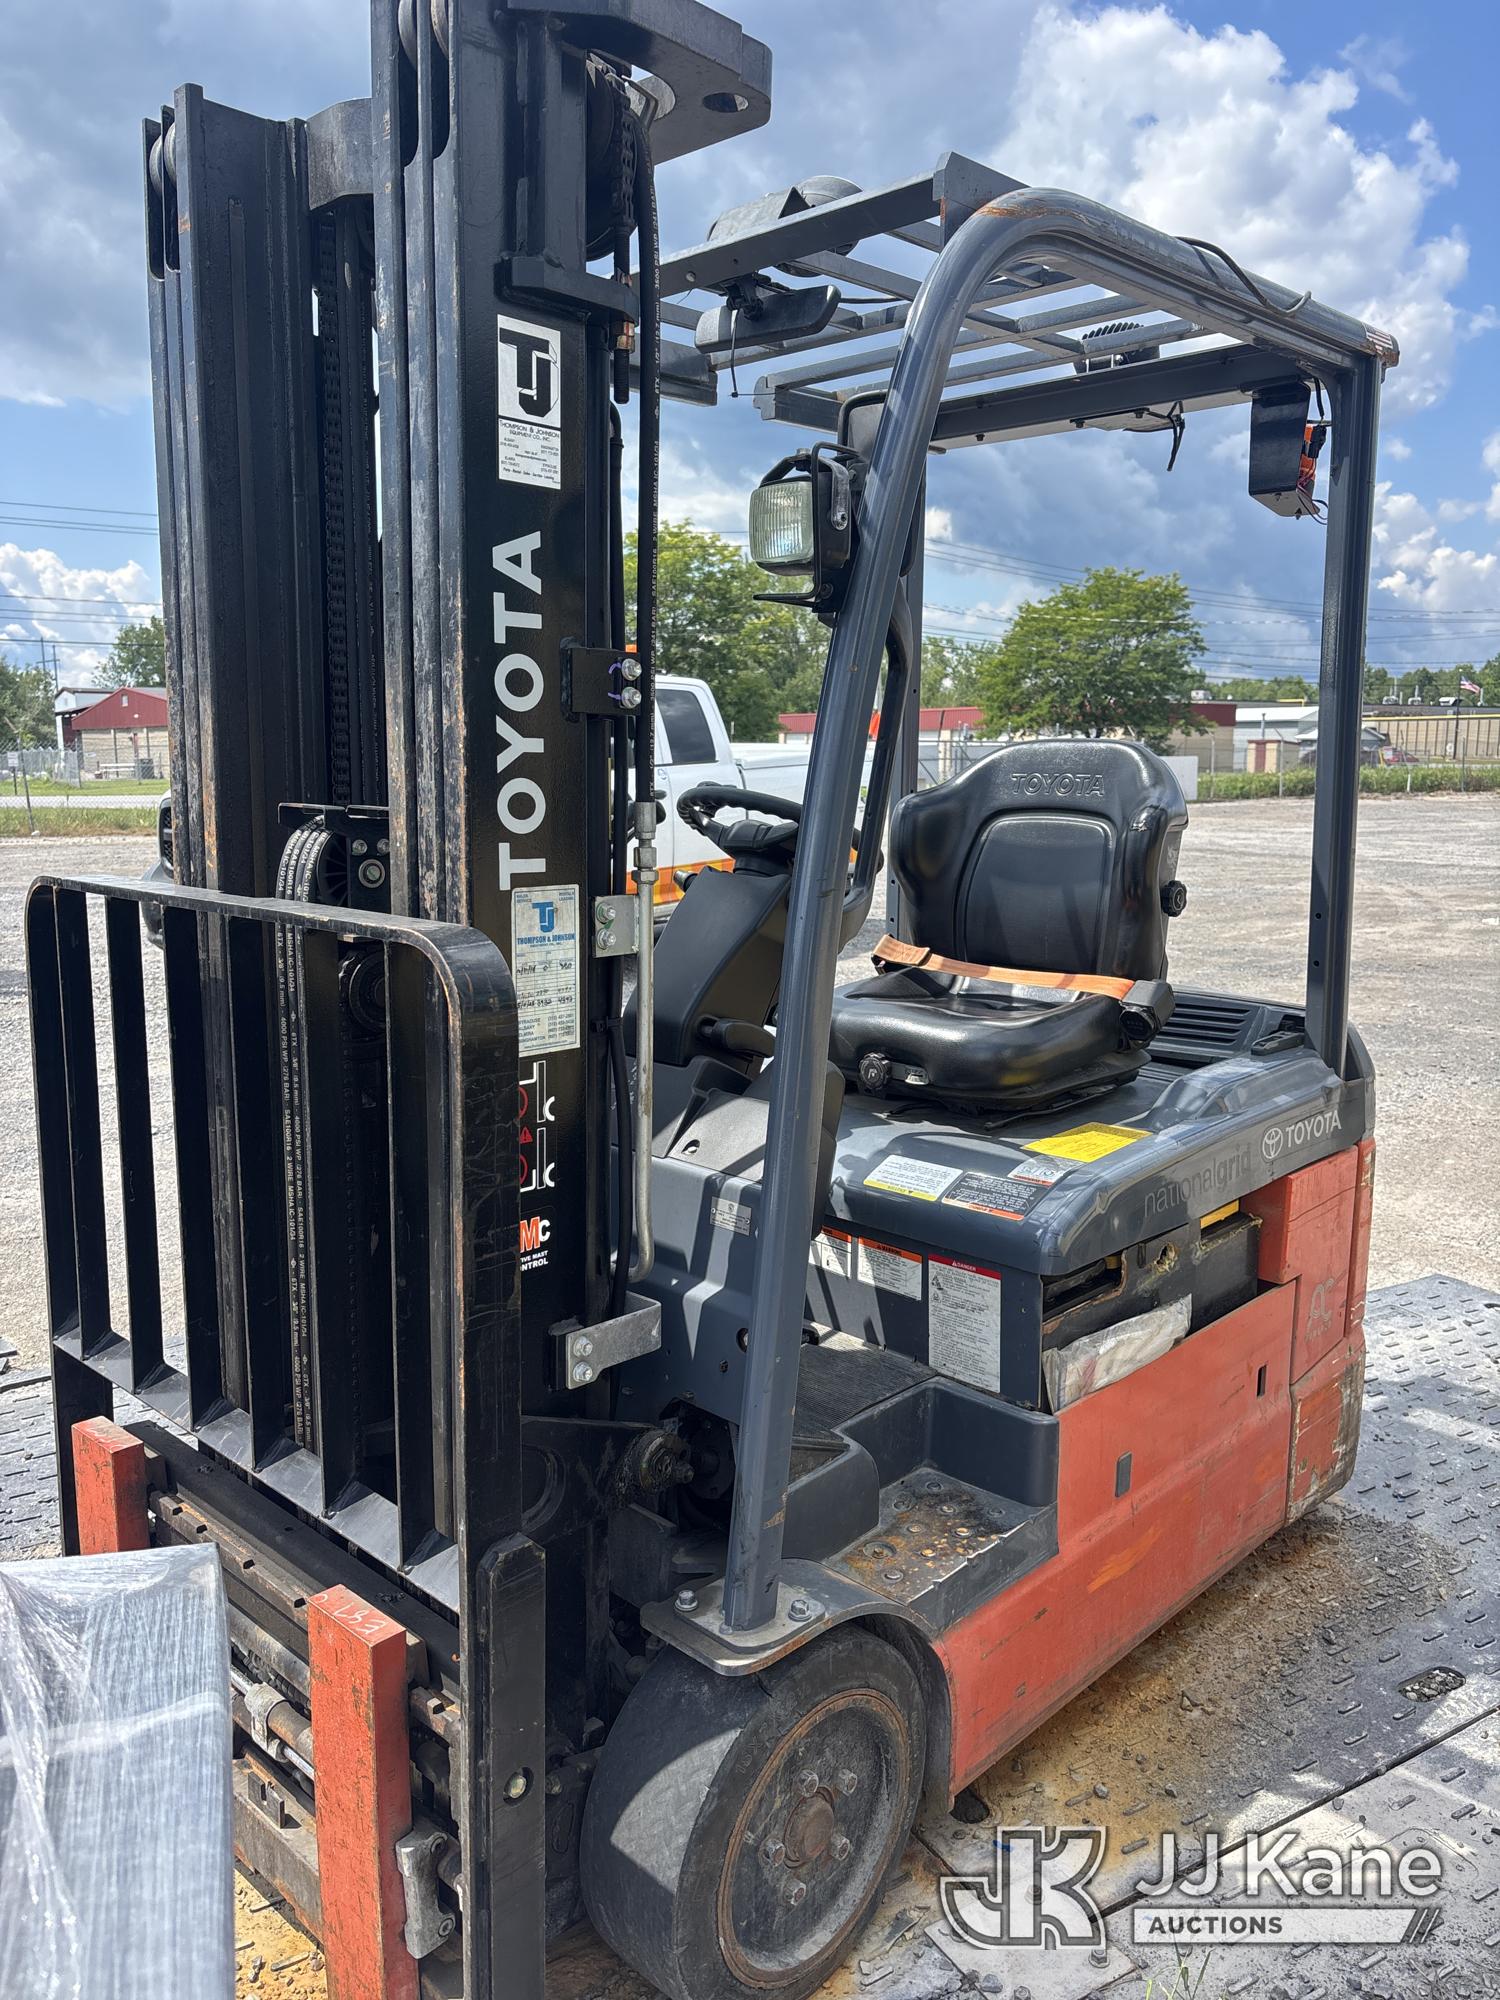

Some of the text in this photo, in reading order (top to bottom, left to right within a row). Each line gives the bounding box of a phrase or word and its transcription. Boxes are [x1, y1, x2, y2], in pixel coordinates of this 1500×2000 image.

[492, 530, 546, 890] TOYOTA
[1010, 773, 1105, 797] TOYOTA
[278, 856, 290, 891] IC-101/34
[286, 848, 300, 895] SAE100R16
[517, 936, 546, 944] THOMPSON
[552, 934, 576, 942] JOHNSON
[1286, 1110, 1342, 1148] TOYOTA
[1144, 1142, 1252, 1218] nationalgrid
[520, 1258, 548, 1272] NTROL
[532, 1250, 548, 1259] MAST
[956, 1262, 976, 1272] DANGER
